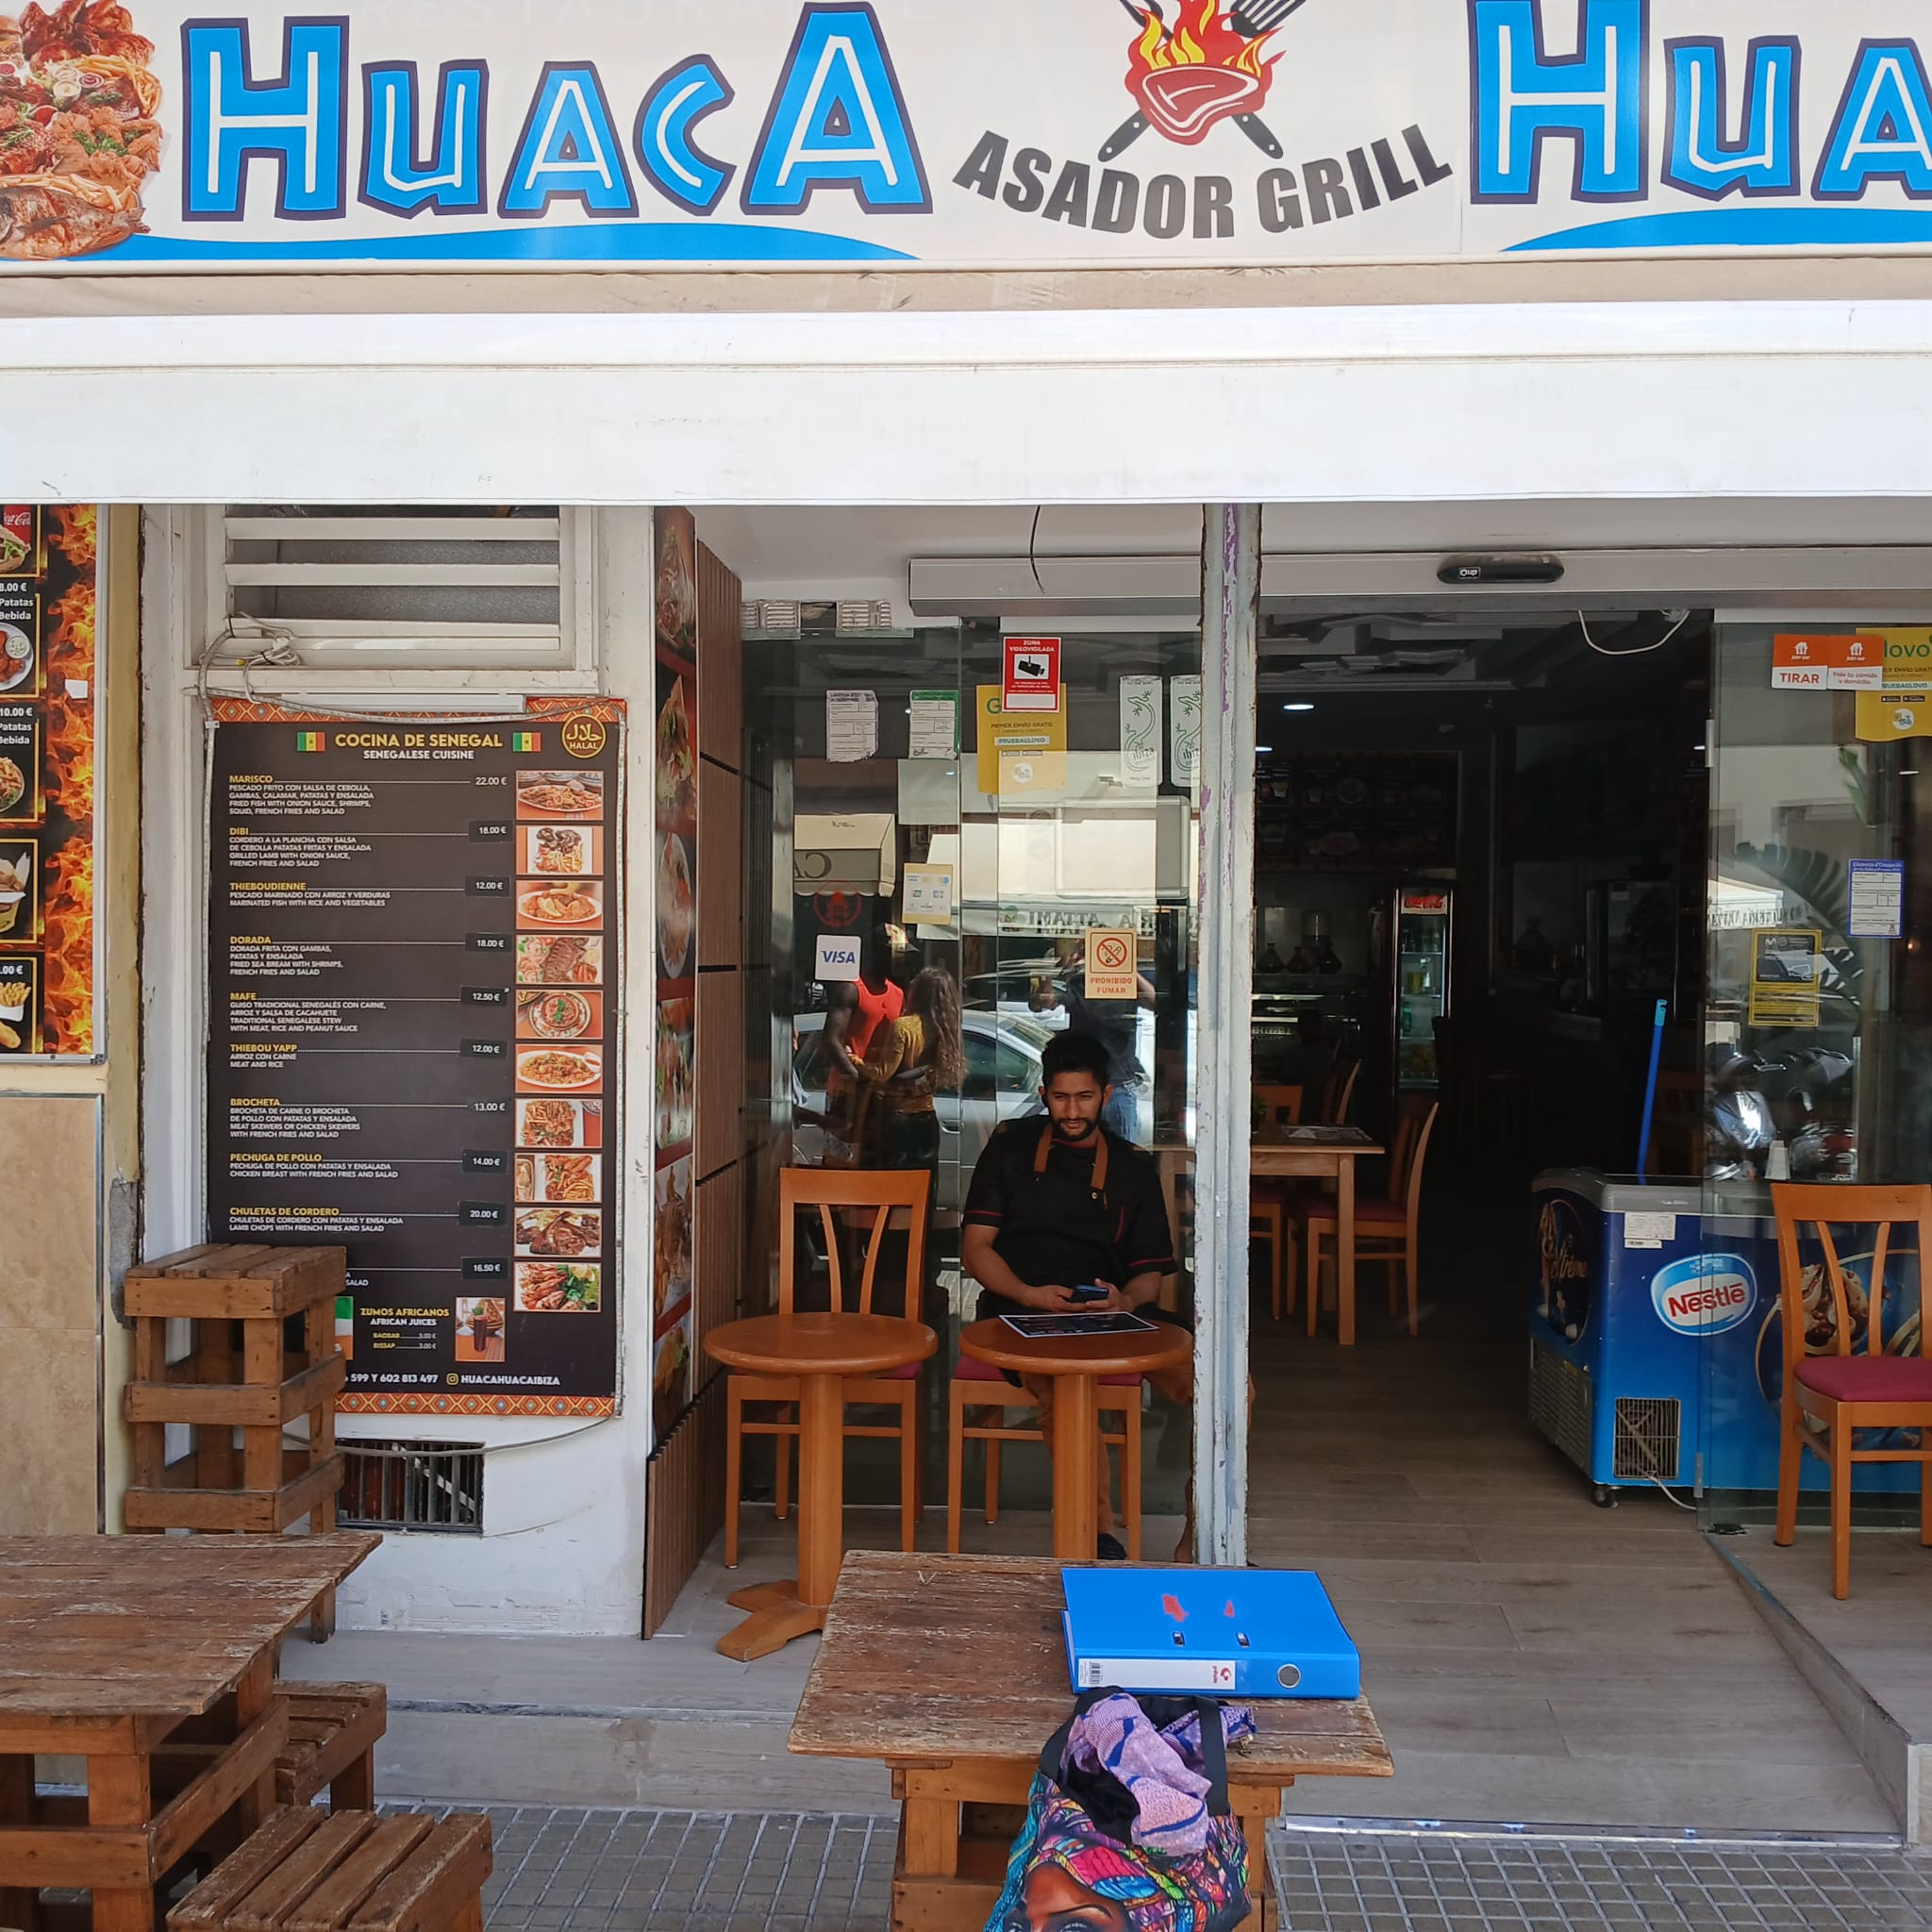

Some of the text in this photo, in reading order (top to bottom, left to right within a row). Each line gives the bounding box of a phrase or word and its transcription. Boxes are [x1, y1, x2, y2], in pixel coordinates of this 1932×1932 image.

[953, 124, 1452, 240] ASADOR GRILL
[21, 583, 26, 591] €
[0, 598, 34, 607] Patatas
[0, 611, 31, 620] Bebida
[1884, 641, 1930, 658] lovo
[1779, 673, 1819, 683] TIRAR
[0, 708, 32, 716] 10.00 €
[336, 734, 502, 747] COCINA DE SENEGAL
[570, 741, 598, 750] HALAL
[364, 751, 474, 759] SENEGALESE CUISINE
[229, 827, 249, 836] DIBI
[475, 882, 493, 891] 12.00
[495, 882, 503, 891] €
[821, 950, 856, 964] VISA
[0, 965, 23, 974] .00 €
[475, 1103, 497, 1111] 13.00
[498, 1103, 505, 1111] €
[230, 1154, 275, 1162] PECHUGA
[276, 1154, 290, 1162] DE
[291, 1154, 322, 1162] POLLO
[1668, 1283, 1745, 1317] Nestlé
[351, 1374, 369, 1382] 599
[371, 1374, 377, 1382] Y
[380, 1374, 400, 1382] 602
[402, 1374, 418, 1383] 813
[420, 1374, 438, 1383] 497
[460, 1375, 560, 1385] HUACAHUACAIBIZA
